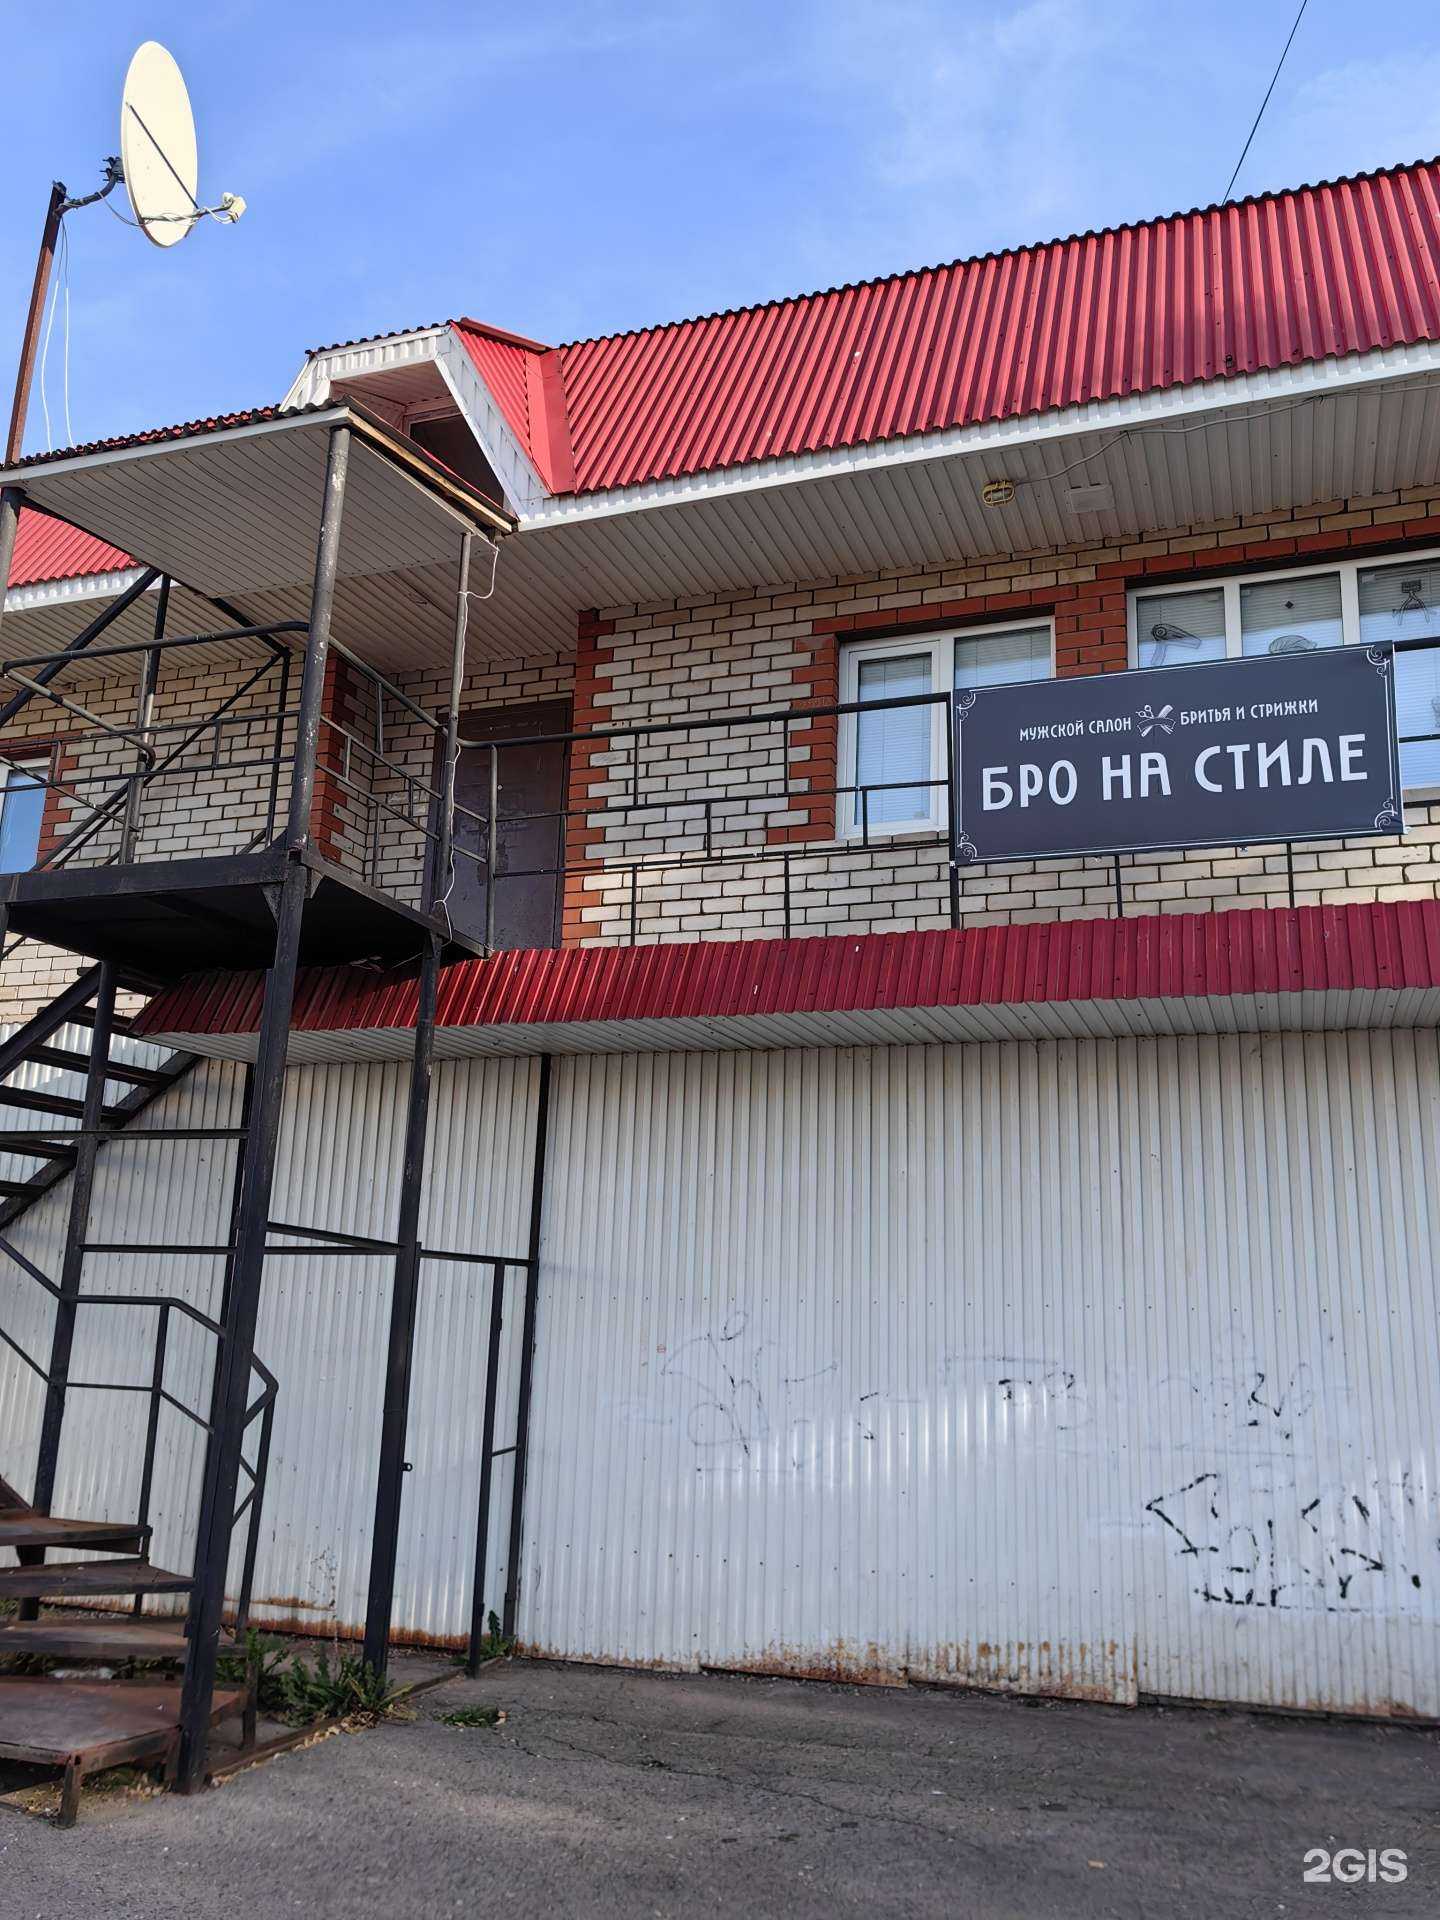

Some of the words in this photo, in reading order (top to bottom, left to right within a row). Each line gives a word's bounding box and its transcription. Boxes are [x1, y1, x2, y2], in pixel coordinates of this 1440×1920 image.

[1019, 719, 1084, 742] МУЖСКОЙ
[1088, 717, 1132, 735] САЛОН
[1180, 706, 1231, 726] БРИТЬЯ
[1236, 705, 1246, 720] И
[1250, 698, 1318, 719] СТРИЖКИ
[982, 759, 1078, 811] БРО
[1102, 752, 1172, 801] НА
[1194, 733, 1368, 793] СТИЛЕ
